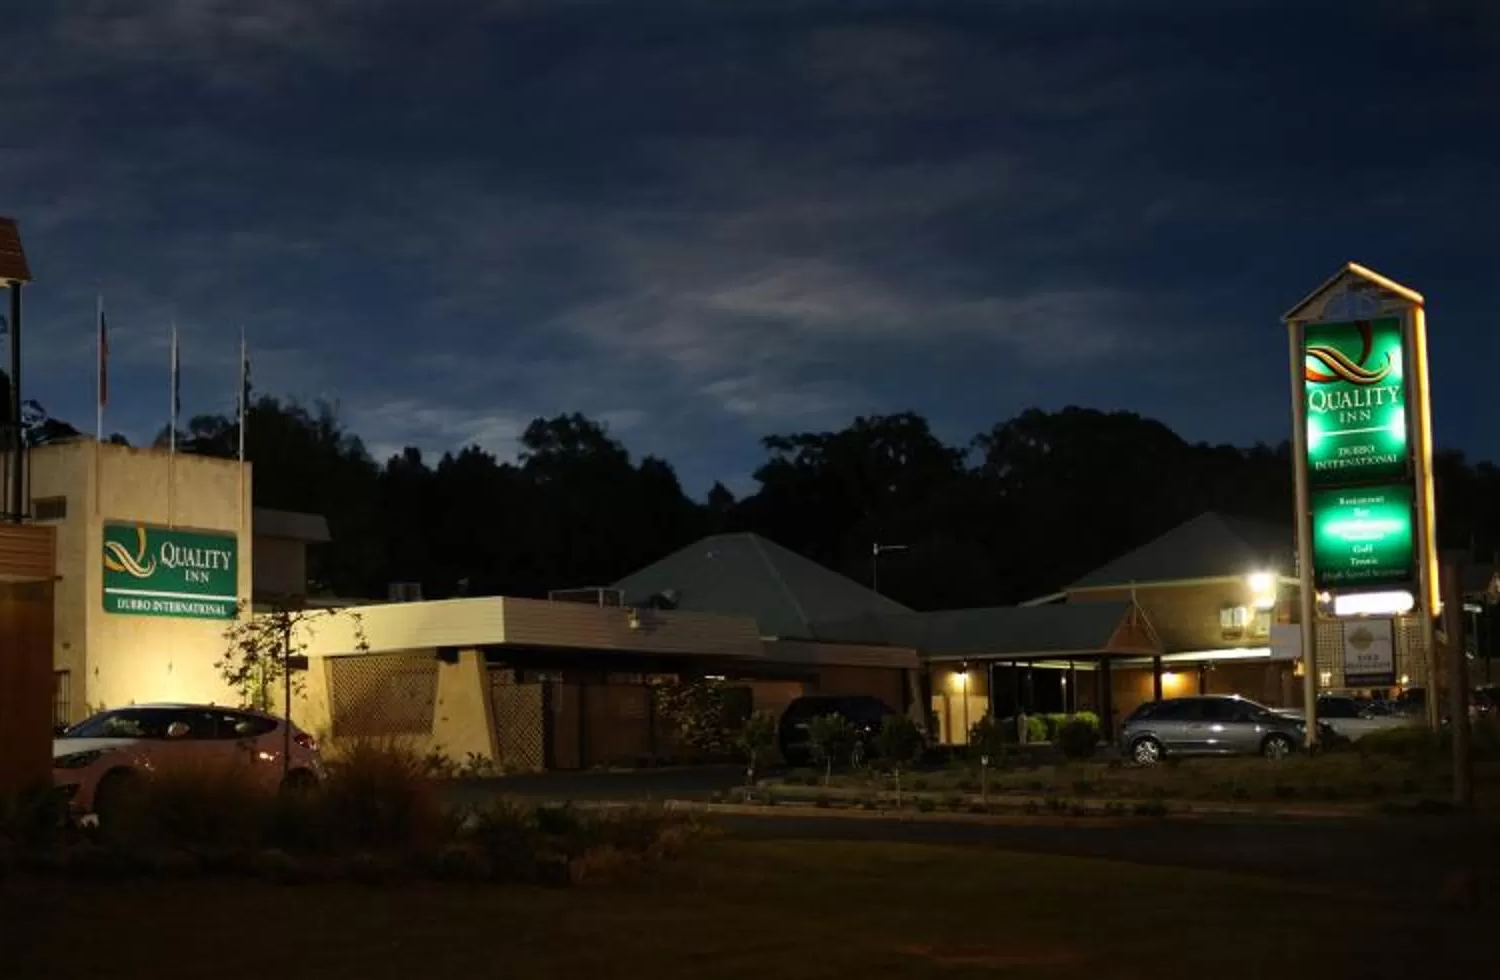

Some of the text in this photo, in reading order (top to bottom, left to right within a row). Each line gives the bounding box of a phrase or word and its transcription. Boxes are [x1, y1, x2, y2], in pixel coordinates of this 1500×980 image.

[1307, 385, 1400, 413] QUALITY
[1339, 409, 1372, 424] INN
[160, 541, 232, 570] QUALITY
[184, 569, 210, 583] INN
